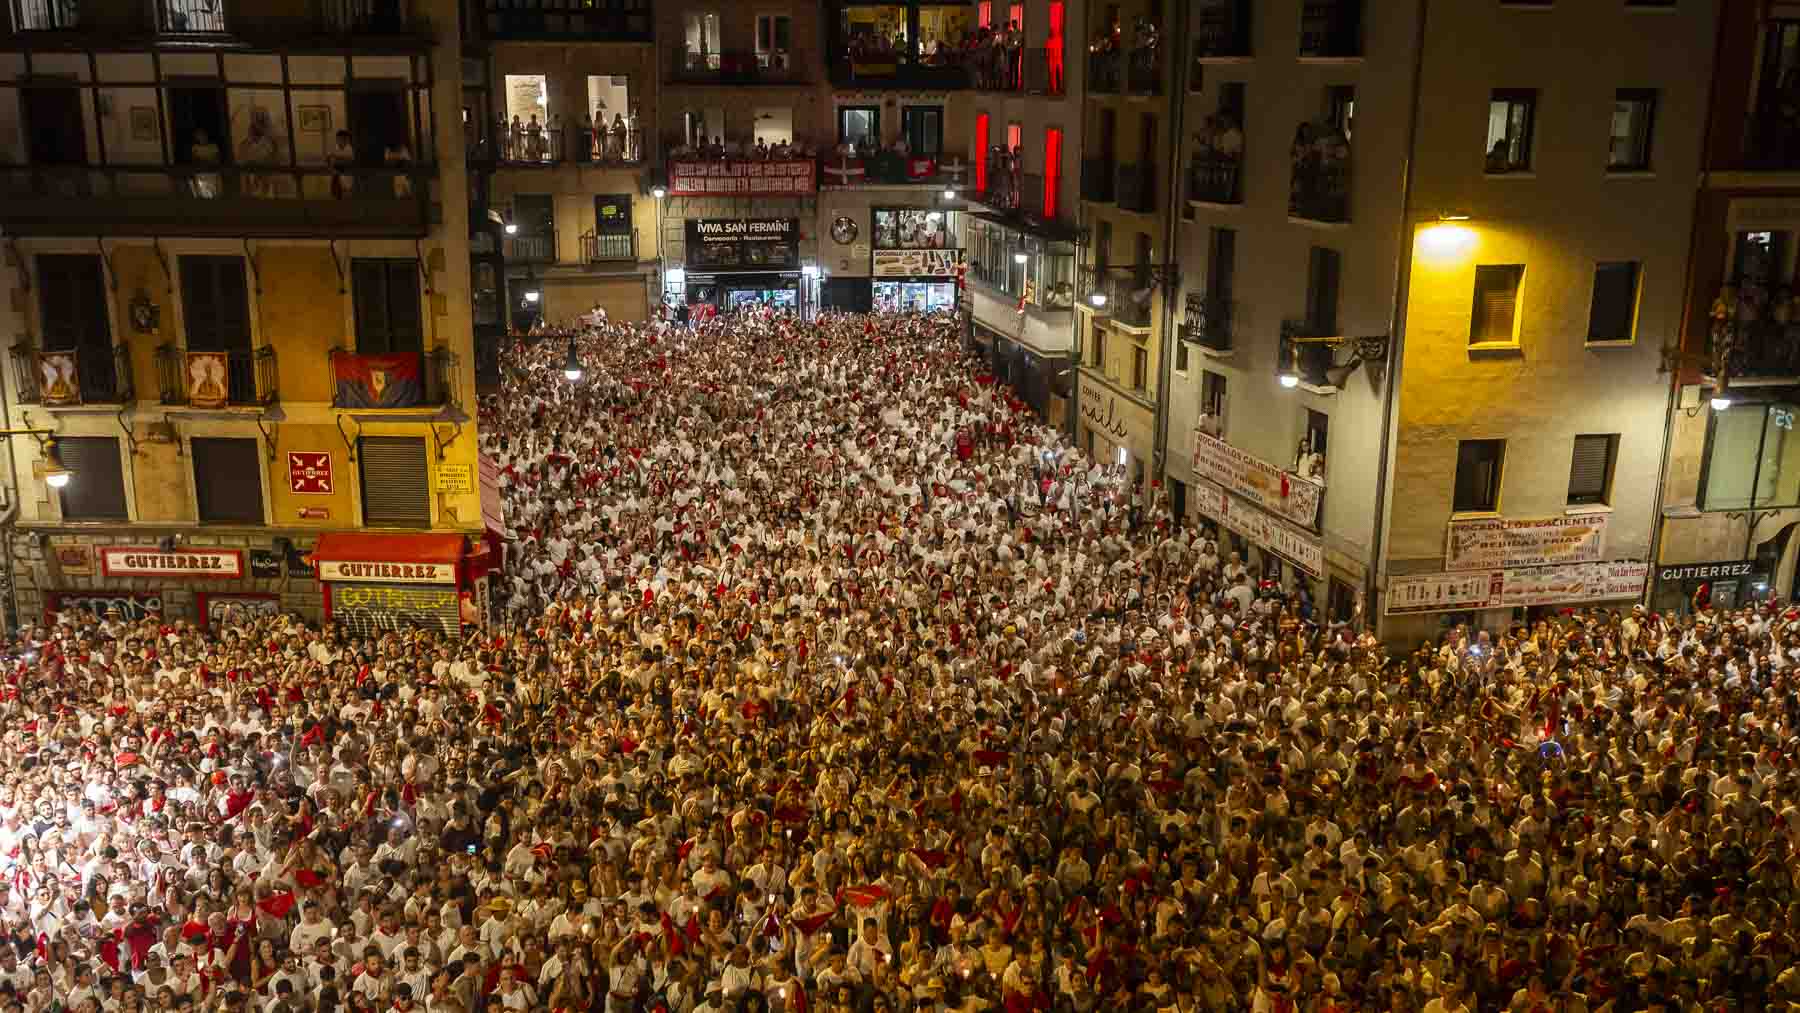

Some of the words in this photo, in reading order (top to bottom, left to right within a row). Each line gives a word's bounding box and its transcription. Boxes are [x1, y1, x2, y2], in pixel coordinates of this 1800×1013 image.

[725, 222, 747, 233] SAN
[1197, 434, 1242, 461] BOCADILLOS
[124, 554, 222, 569] GUTIERREZ
[338, 562, 438, 579] GUTIERREZ
[1662, 563, 1752, 580] GUTIERREZ
